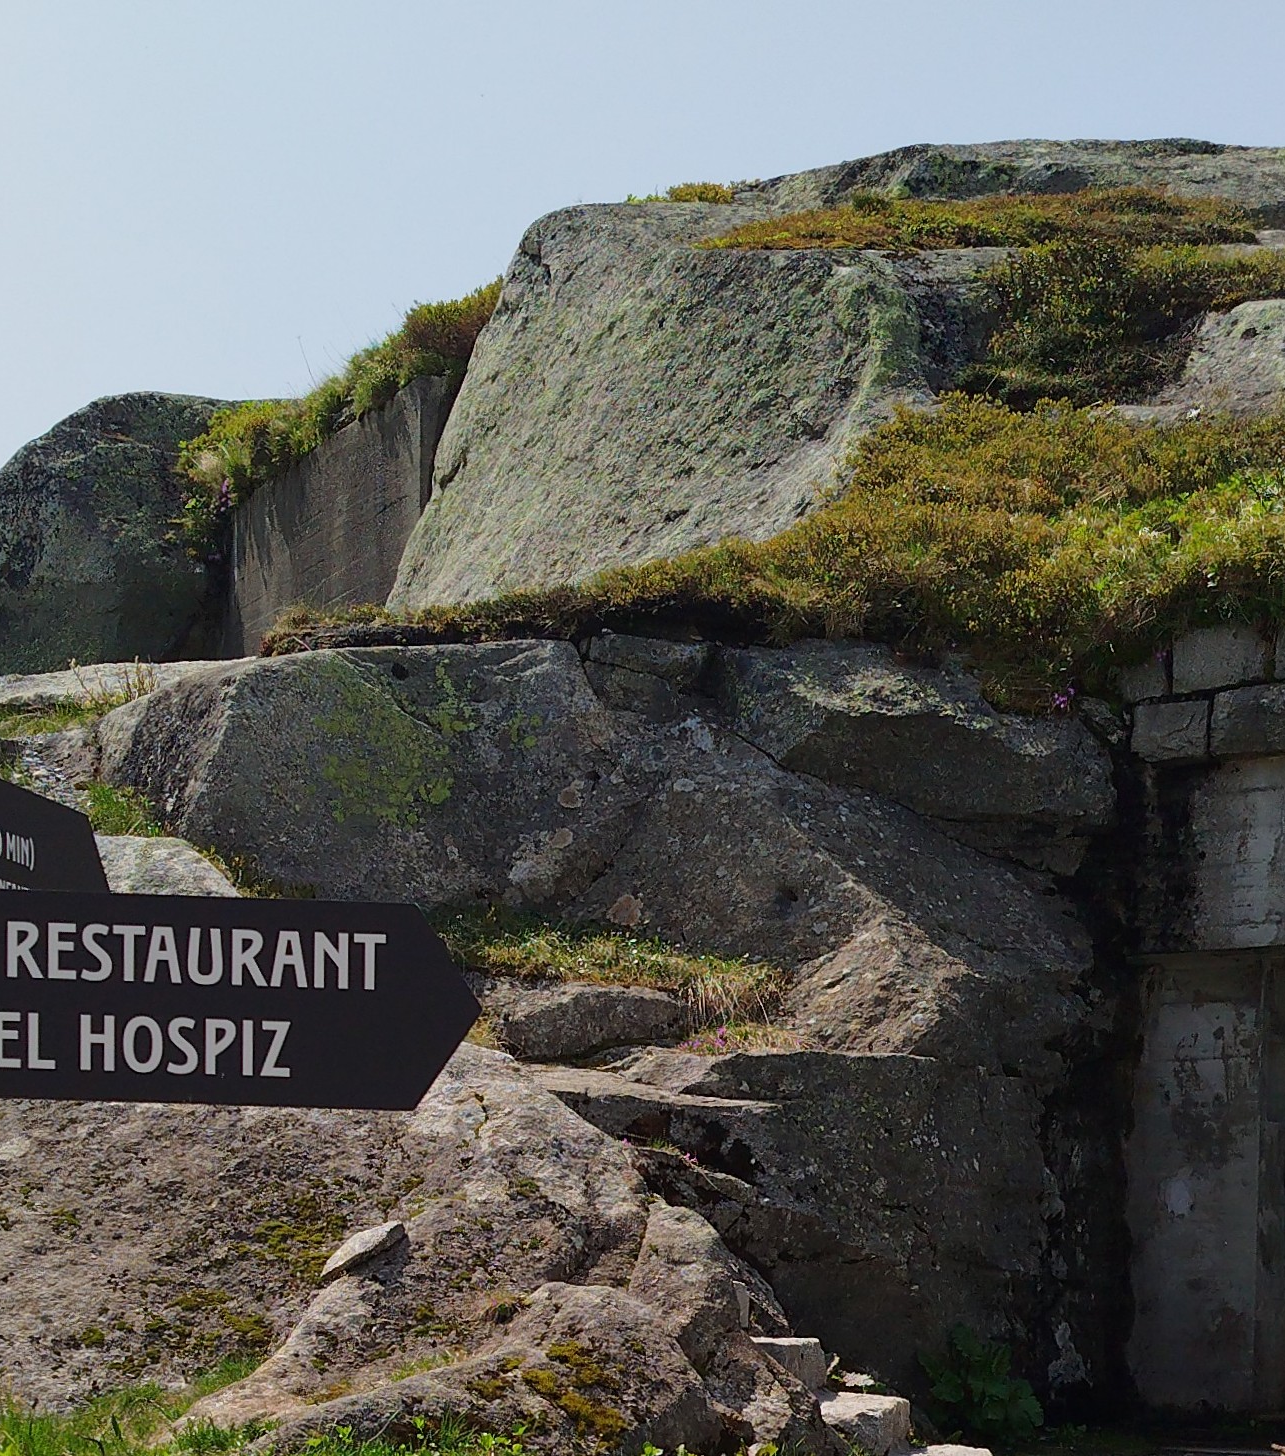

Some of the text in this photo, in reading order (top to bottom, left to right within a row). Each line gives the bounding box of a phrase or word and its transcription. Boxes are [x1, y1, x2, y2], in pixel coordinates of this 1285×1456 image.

[6, 832, 35, 871] MIN)
[6, 920, 387, 991] RESTAURANT
[79, 1014, 291, 1078] HOSPIZ
